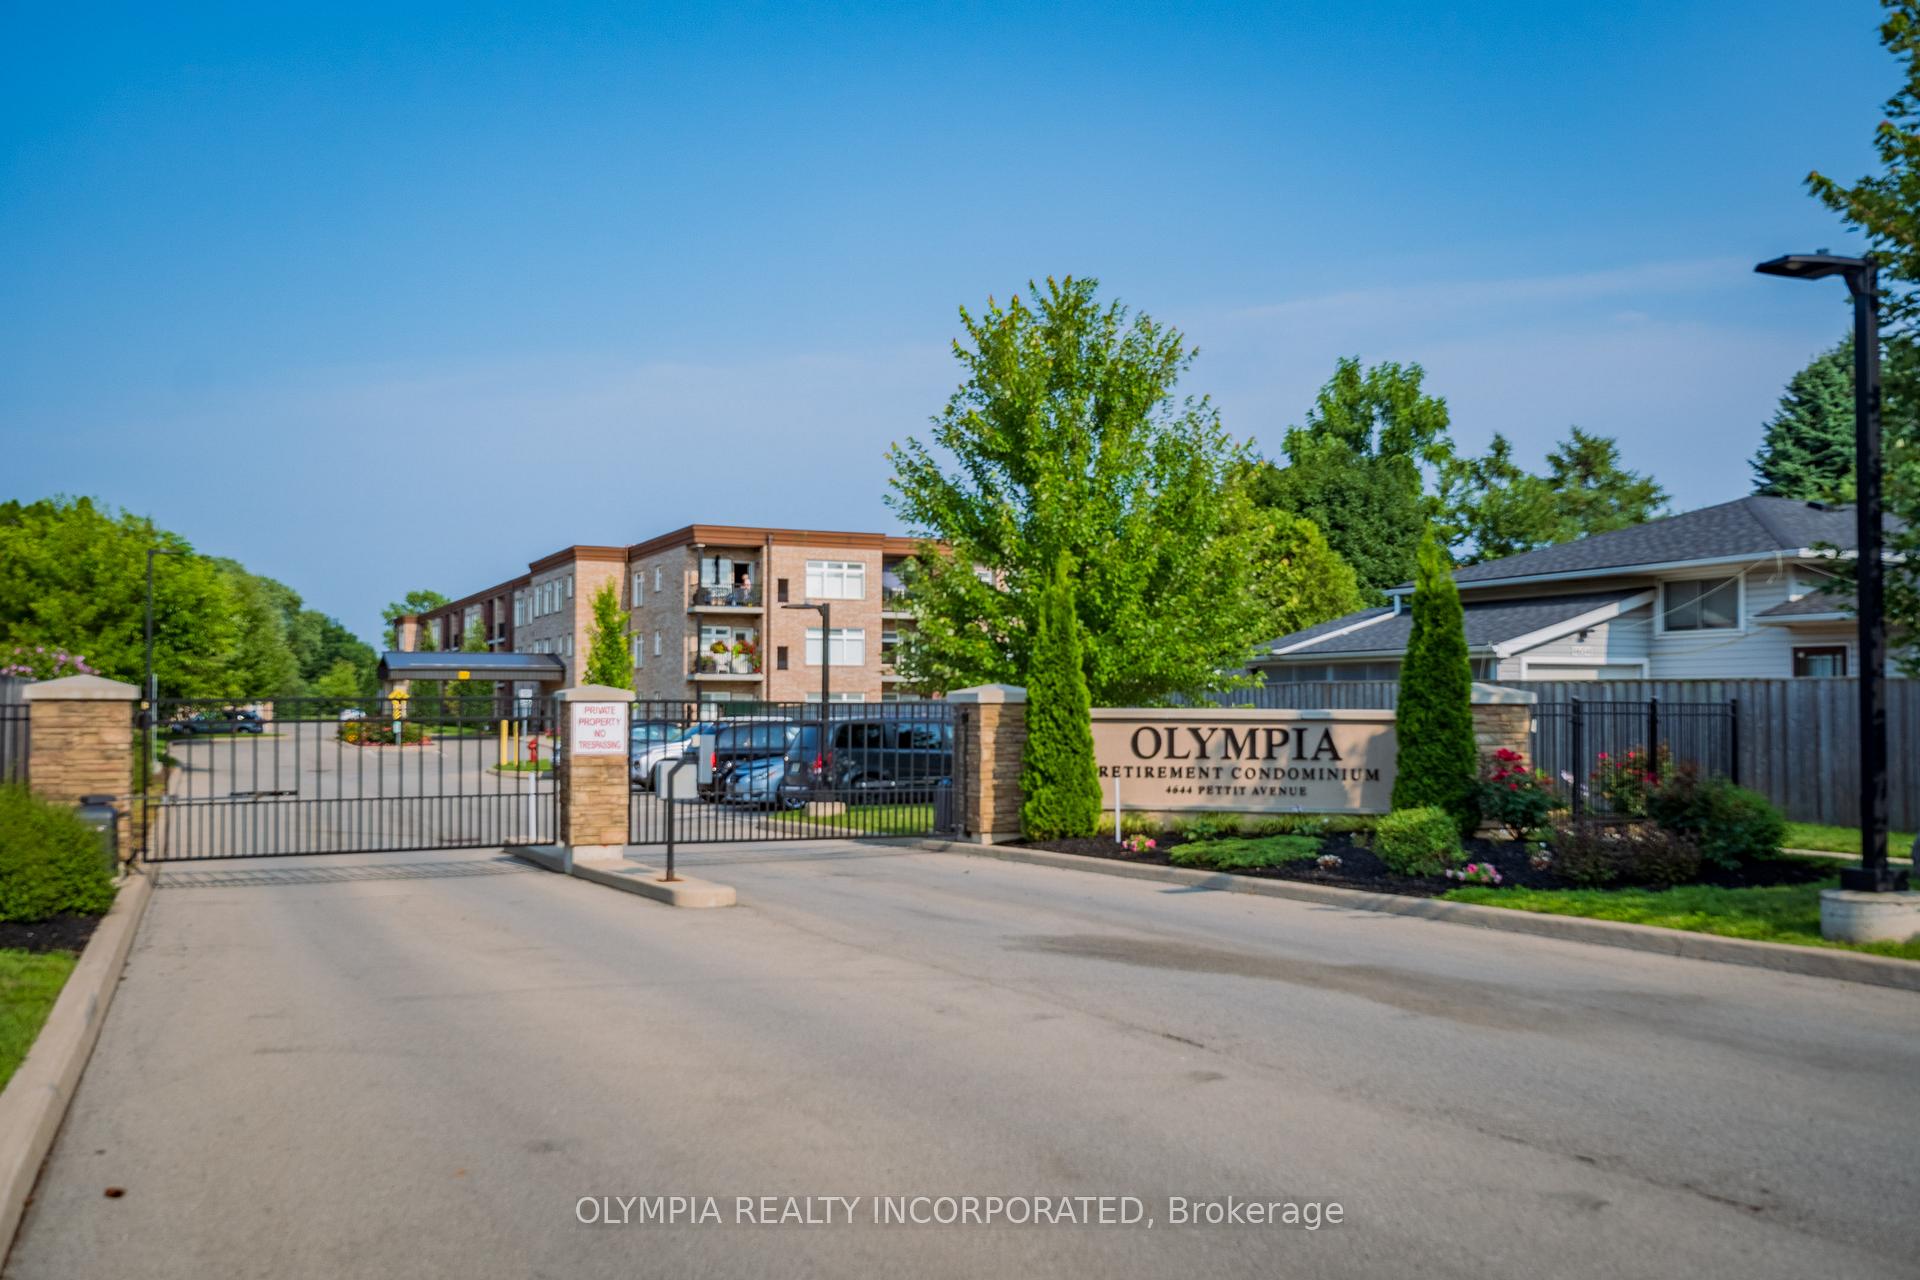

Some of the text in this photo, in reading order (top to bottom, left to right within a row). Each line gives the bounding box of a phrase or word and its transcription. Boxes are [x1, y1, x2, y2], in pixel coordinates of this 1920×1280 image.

[584, 705, 617, 715] PRIVATE
[578, 717, 622, 727] PROPERTY
[593, 729, 607, 738] NO
[578, 740, 622, 750] TRESPASSING
[1130, 726, 1342, 762] OLYMPIA
[1098, 765, 1381, 782] RETIREMENT CONDOMINIUM
[1165, 785, 1308, 797] 4644 PETTIT AVENUE
